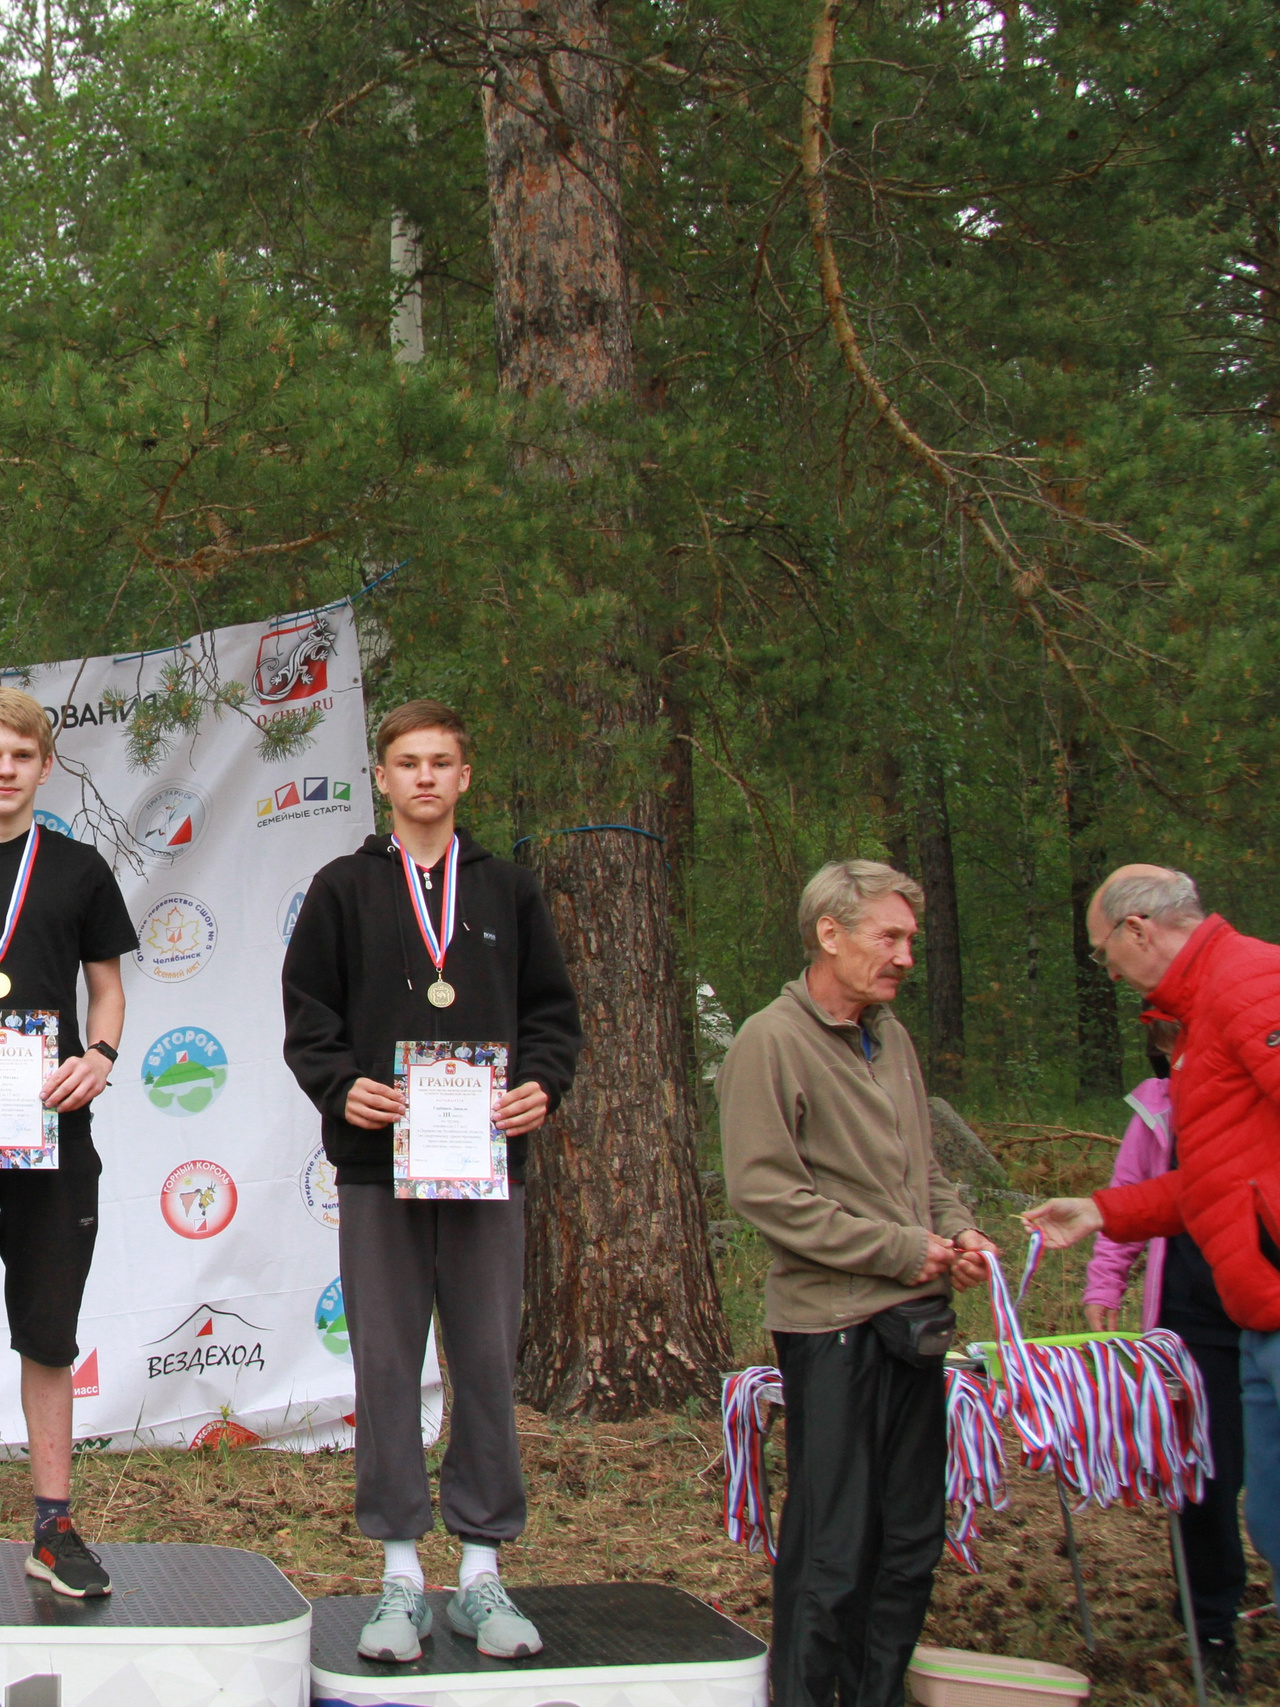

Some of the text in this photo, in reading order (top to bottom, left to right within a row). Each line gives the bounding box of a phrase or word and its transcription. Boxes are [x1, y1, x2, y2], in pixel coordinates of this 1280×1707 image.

[256, 804, 352, 829] СЕМЕЙНЫЕ СТАРТЫ
[152, 952, 202, 965] Челябинск
[148, 1030, 219, 1067] БУГОРОК
[418, 1076, 482, 1088] ГРАМОТА
[163, 1161, 232, 1193] ГОРНЫЙ КОРОЛЬ
[147, 1342, 265, 1379] ВЕЗДЕХОД
[73, 1384, 99, 1396] иасс
